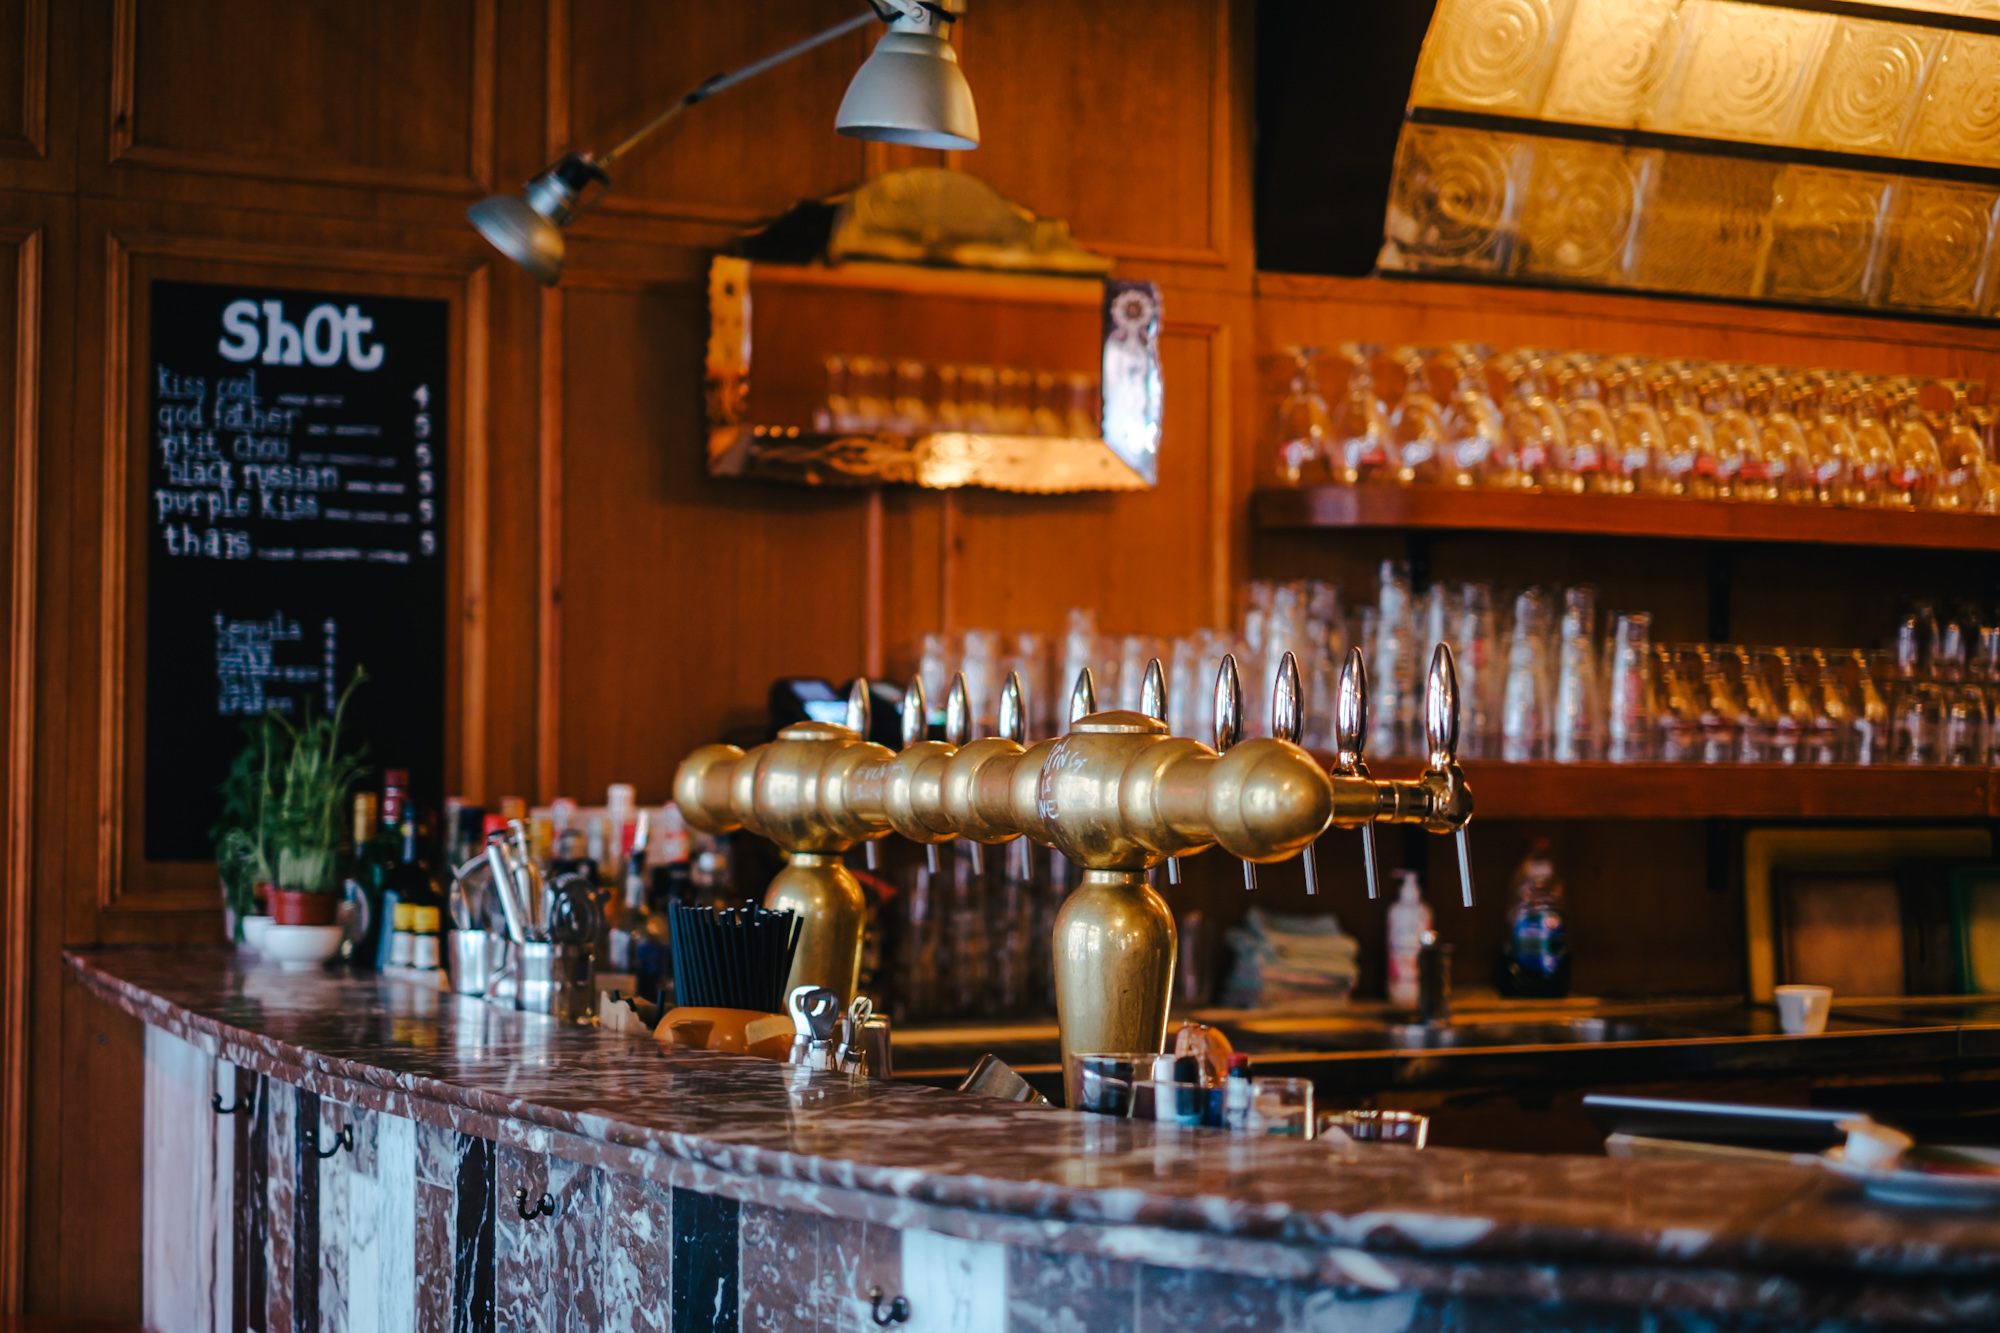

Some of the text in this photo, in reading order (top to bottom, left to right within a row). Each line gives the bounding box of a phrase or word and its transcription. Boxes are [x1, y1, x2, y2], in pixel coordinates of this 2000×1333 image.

[169, 458, 235, 489] black
[242, 463, 339, 491] russian
[154, 488, 251, 524] purple
